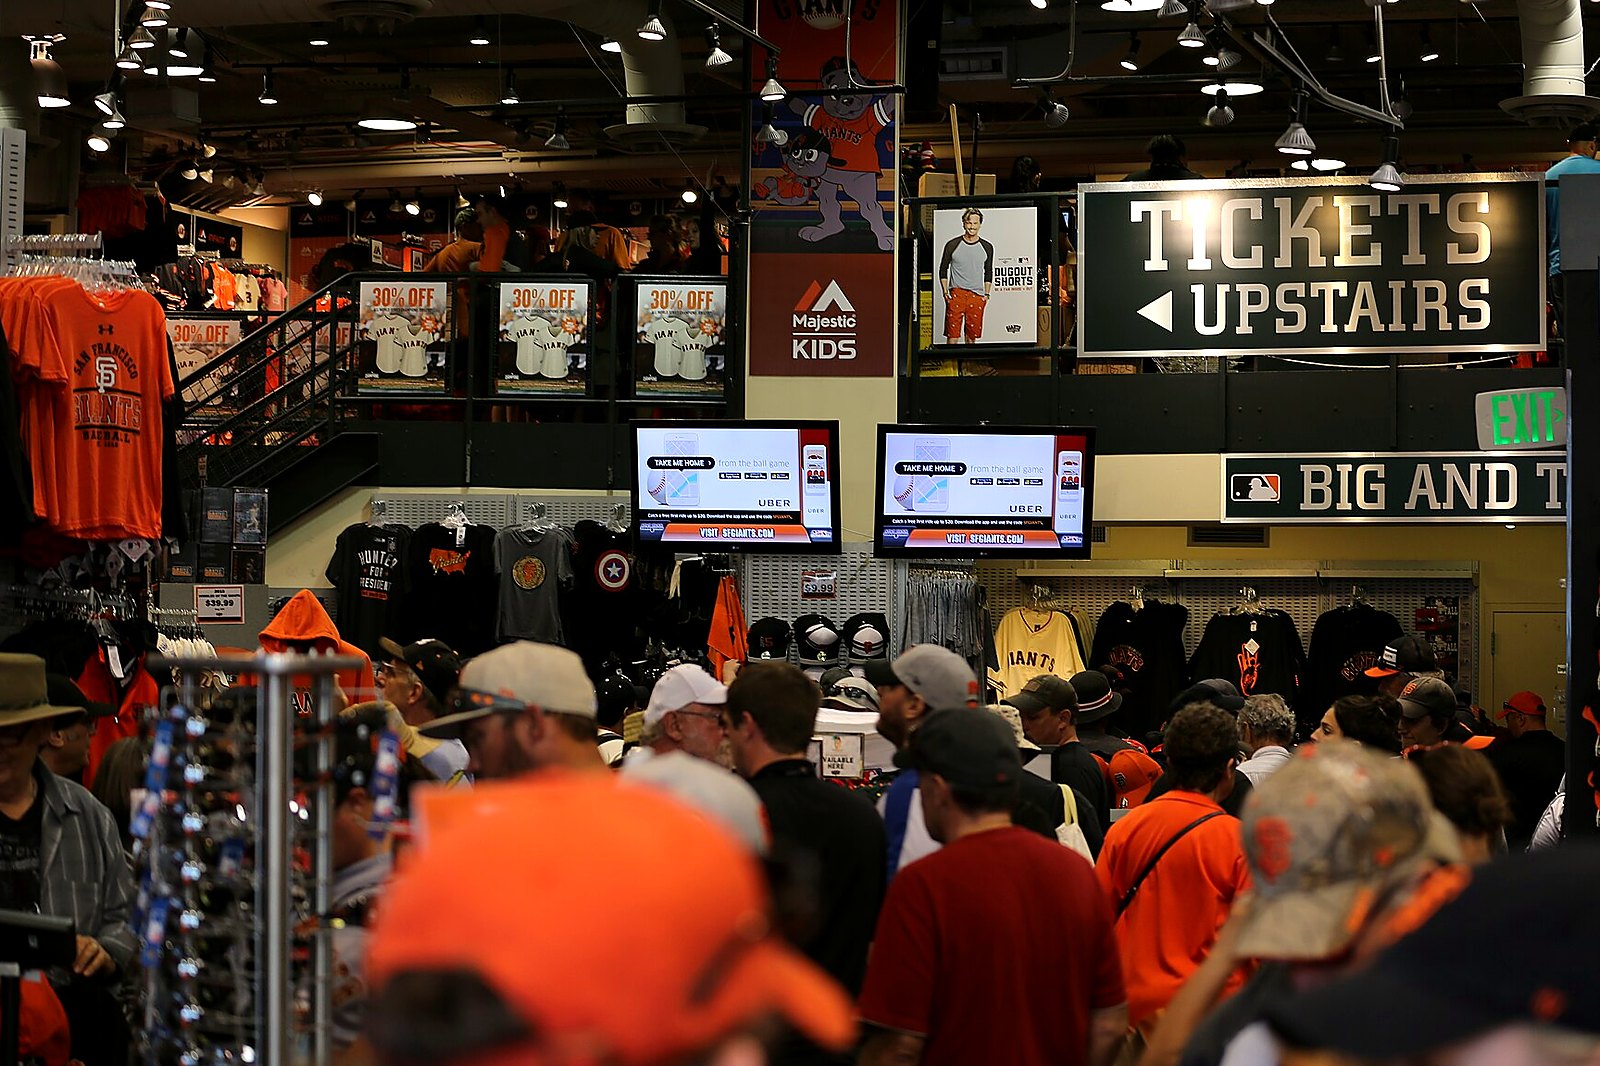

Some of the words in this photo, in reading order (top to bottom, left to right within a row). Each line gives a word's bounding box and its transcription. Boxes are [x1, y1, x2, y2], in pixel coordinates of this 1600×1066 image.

[1130, 191, 1492, 272] TICKETS
[995, 267, 1032, 276] DUGOUT
[995, 277, 1032, 286] SHORTS
[373, 288, 404, 307] 30%
[408, 288, 434, 307] OFF
[513, 289, 544, 308] 30%
[549, 289, 575, 308] OFF
[651, 290, 683, 310] 30%
[687, 290, 714, 310] OFF
[1190, 278, 1491, 336] UPSTAIRS
[793, 313, 857, 331] Majestic
[174, 325, 202, 342] 30%
[206, 325, 230, 342] OFF
[792, 339, 857, 359] KIDS
[74, 350, 91, 375] SAN
[91, 343, 138, 379] FRANCISCO
[74, 393, 141, 428] INTS
[1491, 391, 1556, 445] EXIT
[654, 459, 671, 467] TAKE
[672, 459, 683, 467] ME
[684, 459, 704, 467] HOME
[719, 459, 737, 467] from
[739, 459, 751, 467] the
[753, 459, 766, 467] ball
[922, 464, 933, 472] ME
[971, 465, 990, 473] from
[992, 465, 1006, 473] the
[1006, 465, 1020, 473] ball
[1022, 467, 1044, 475] game
[1300, 464, 1385, 510] BIG
[1405, 463, 1517, 510] AND
[759, 499, 790, 507] UBER
[1010, 505, 1043, 513] UBER
[700, 528, 719, 538] VISIT
[722, 528, 775, 539] SFGIANTS.COM
[946, 533, 966, 544] VISIT
[969, 533, 1025, 544] SFGIANTS.COM
[358, 550, 398, 569] HUNTER
[804, 584, 833, 593] $9.99
[205, 599, 234, 607] $39.99
[1009, 651, 1056, 672] IANTS
